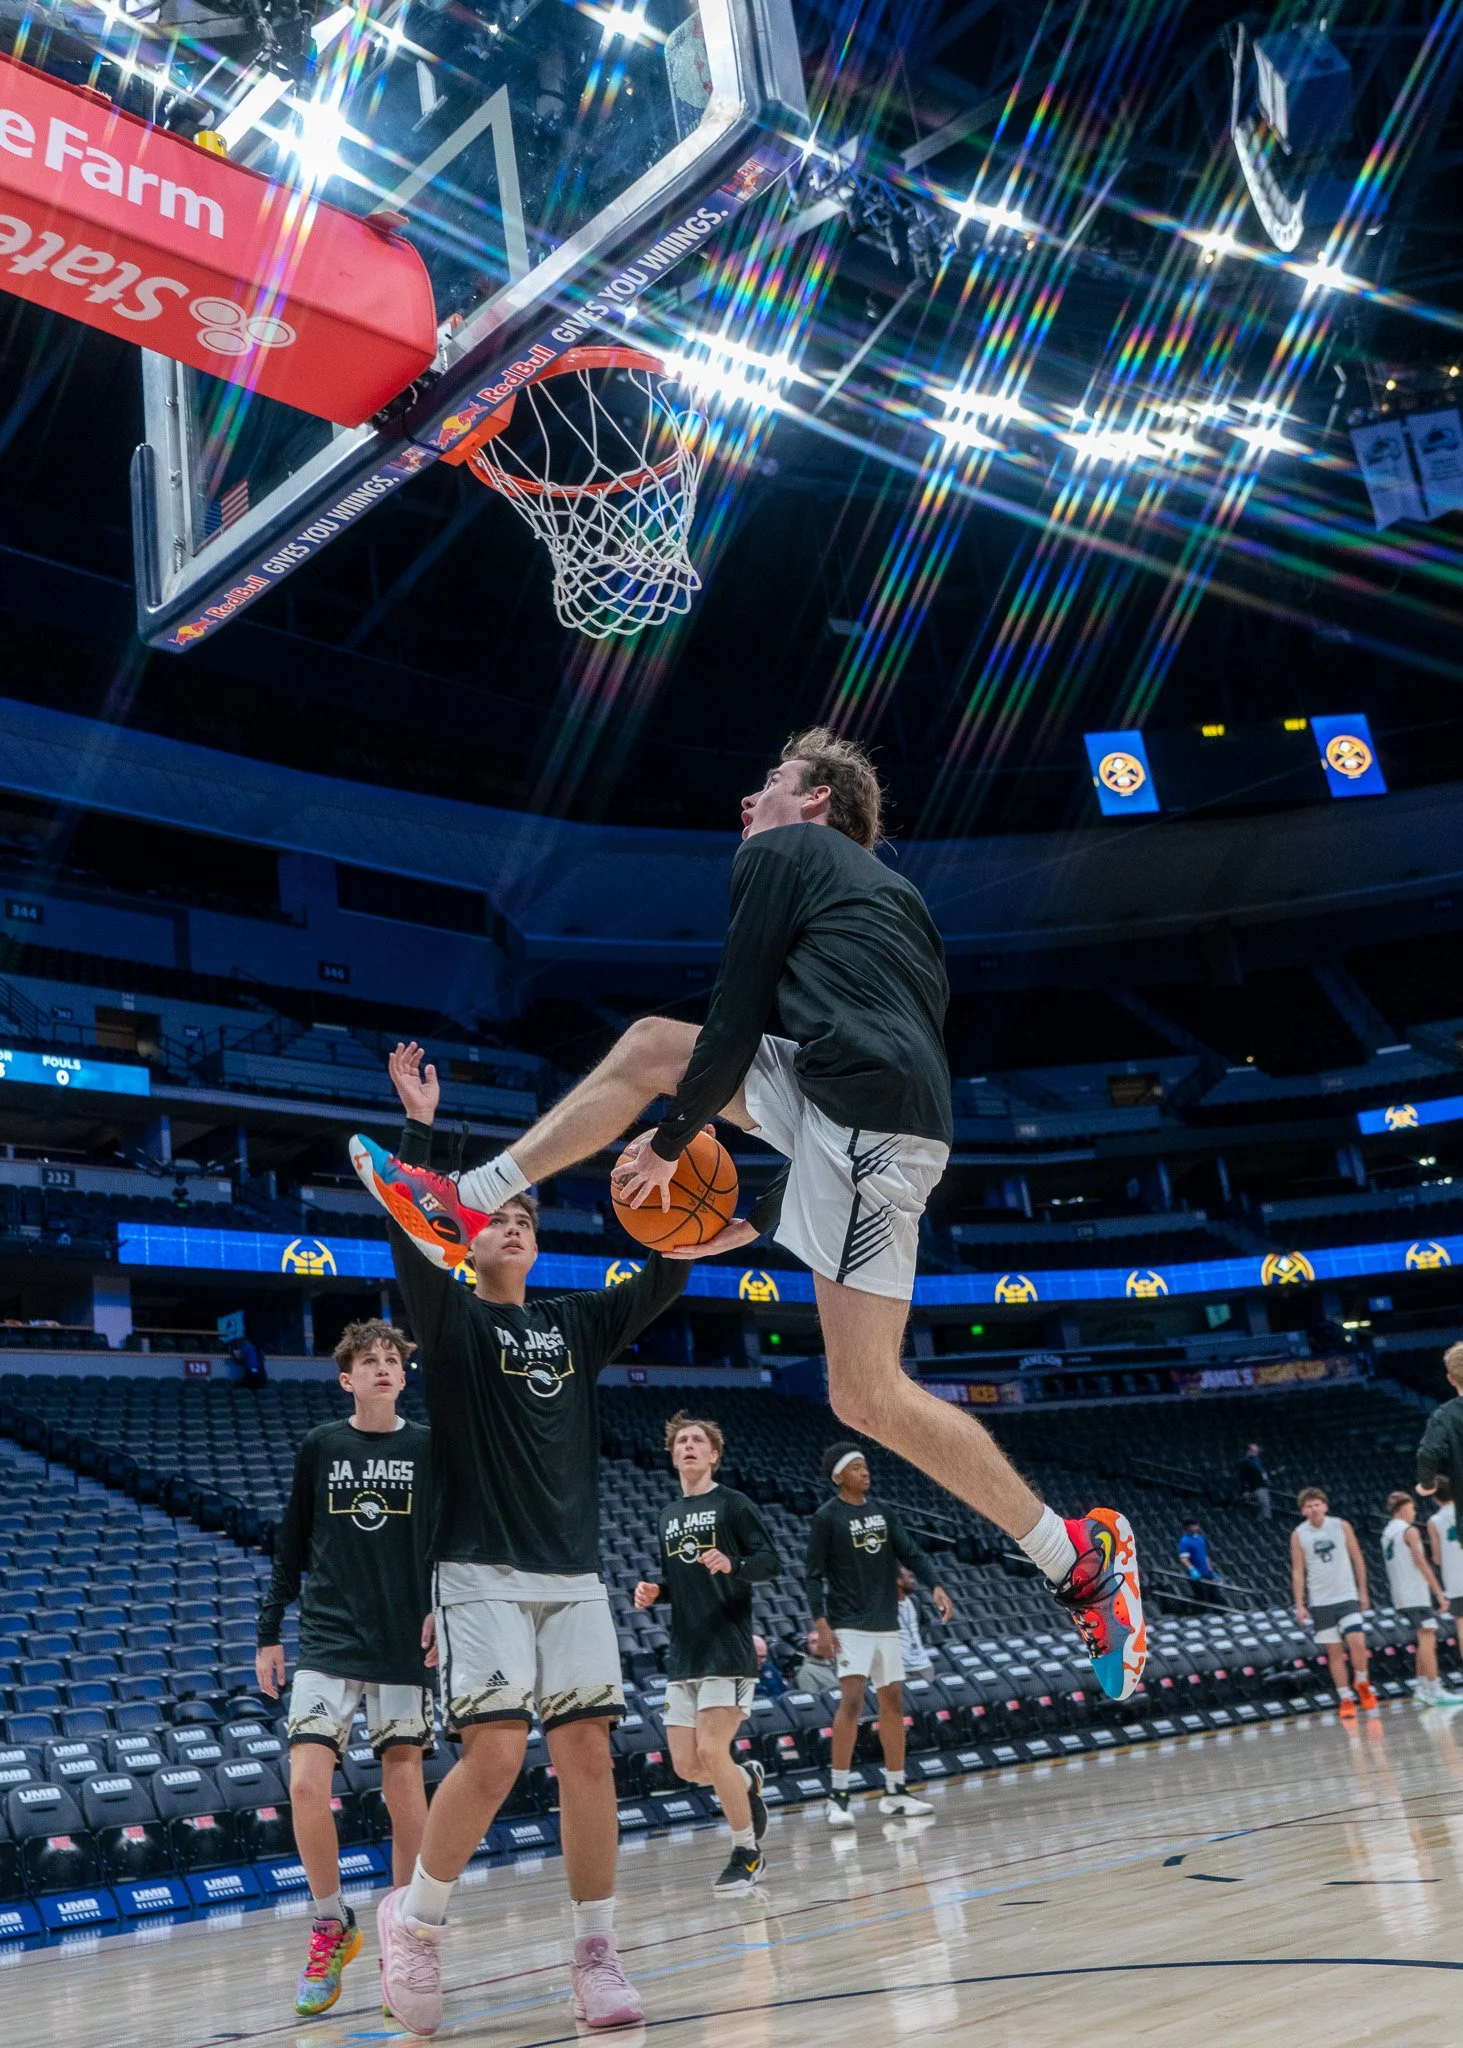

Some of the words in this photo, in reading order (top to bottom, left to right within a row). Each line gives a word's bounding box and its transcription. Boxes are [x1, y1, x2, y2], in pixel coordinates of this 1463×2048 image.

[45, 117, 224, 239] Farm
[552, 300, 609, 343] GIVES
[597, 267, 649, 302] YOU
[262, 542, 310, 574] GIVES
[297, 518, 340, 544] YOU
[42, 1055, 82, 1071] FOULS
[56, 1069, 70, 1085] 0
[328, 1460, 354, 1481] JA
[362, 1459, 414, 1481] JAGS
[328, 1481, 413, 1490] BASKETBALL
[665, 1518, 680, 1535] JA
[683, 1510, 717, 1529] JAGS
[173, 1730, 207, 1743] UMB
[229, 1724, 262, 1738] UMB
[52, 1743, 89, 1758] UMB
[115, 1737, 150, 1750] UMB
[246, 1739, 281, 1754] UMB
[0, 1750, 26, 1764] MB
[124, 1753, 162, 1767] UMB
[186, 1745, 222, 1760] UMB
[349, 1748, 374, 1761] UM
[58, 1759, 98, 1775] UMB
[224, 1762, 263, 1778] UMB
[161, 1770, 201, 1785] UMB
[91, 1778, 133, 1794] UMB
[18, 1787, 61, 1803] UMB
[203, 1875, 242, 1891] UMB
[276, 1876, 309, 1887] RESERV
[132, 1886, 172, 1902] UMB
[208, 1886, 245, 1898] RESERVE
[57, 1898, 99, 1914] UMB
[136, 1898, 175, 1910] RESERVE
[0, 1912, 22, 1926] MB
[60, 1909, 101, 1922] RESERVE
